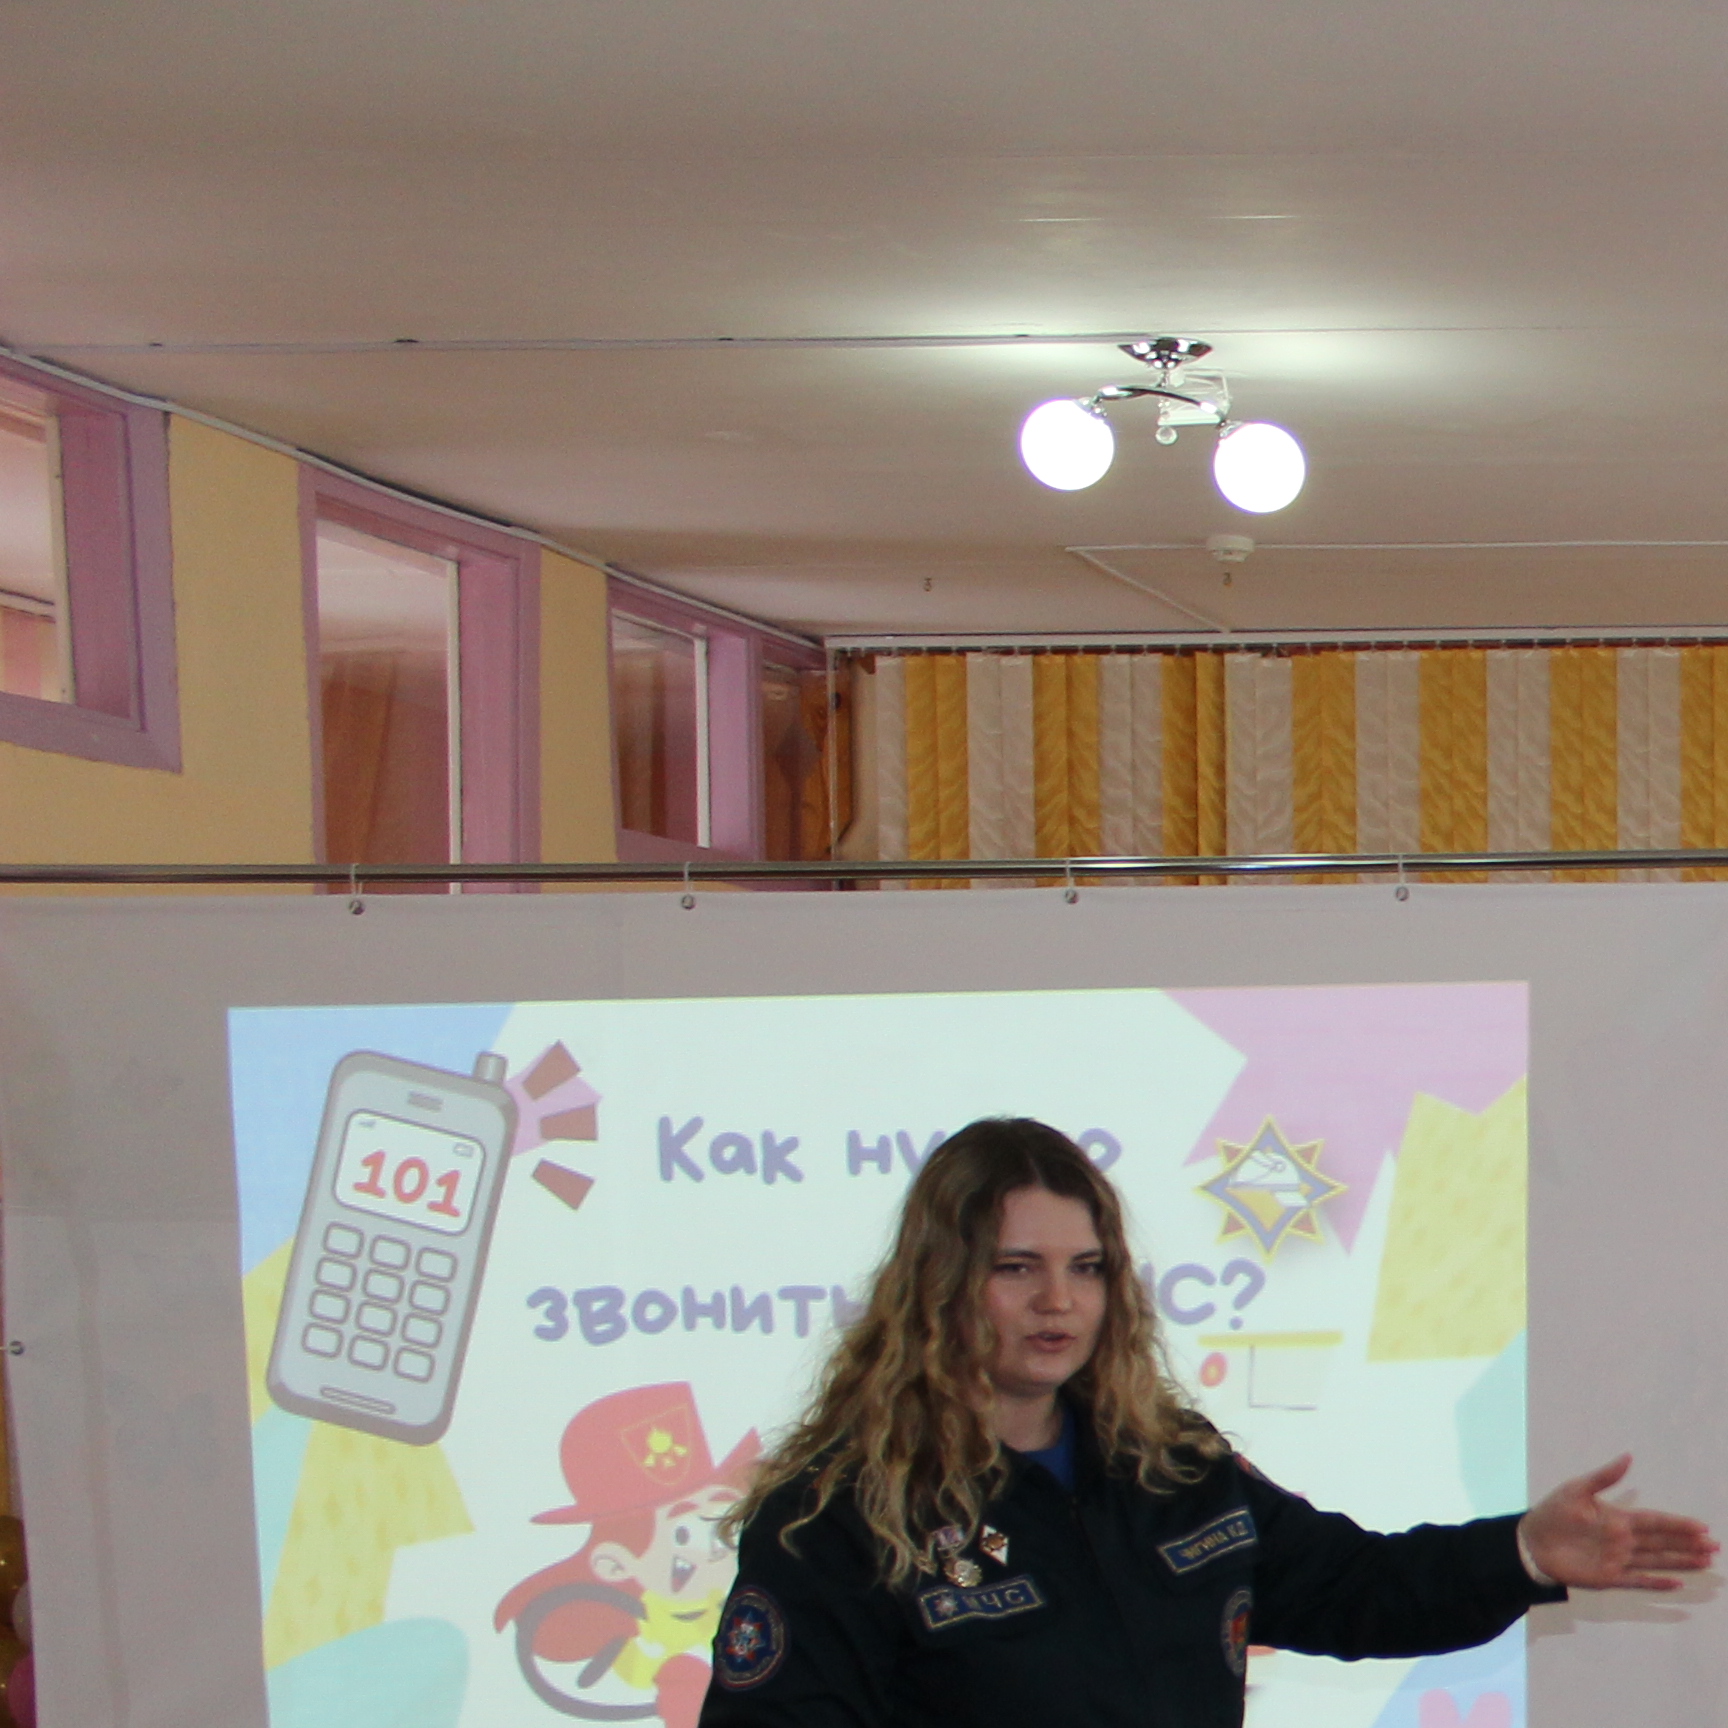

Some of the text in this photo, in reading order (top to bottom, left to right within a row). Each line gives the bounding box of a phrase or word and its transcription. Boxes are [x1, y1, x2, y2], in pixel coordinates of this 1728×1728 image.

[352, 1148, 462, 1219] 101
[657, 1114, 1122, 1185] Как нуо
